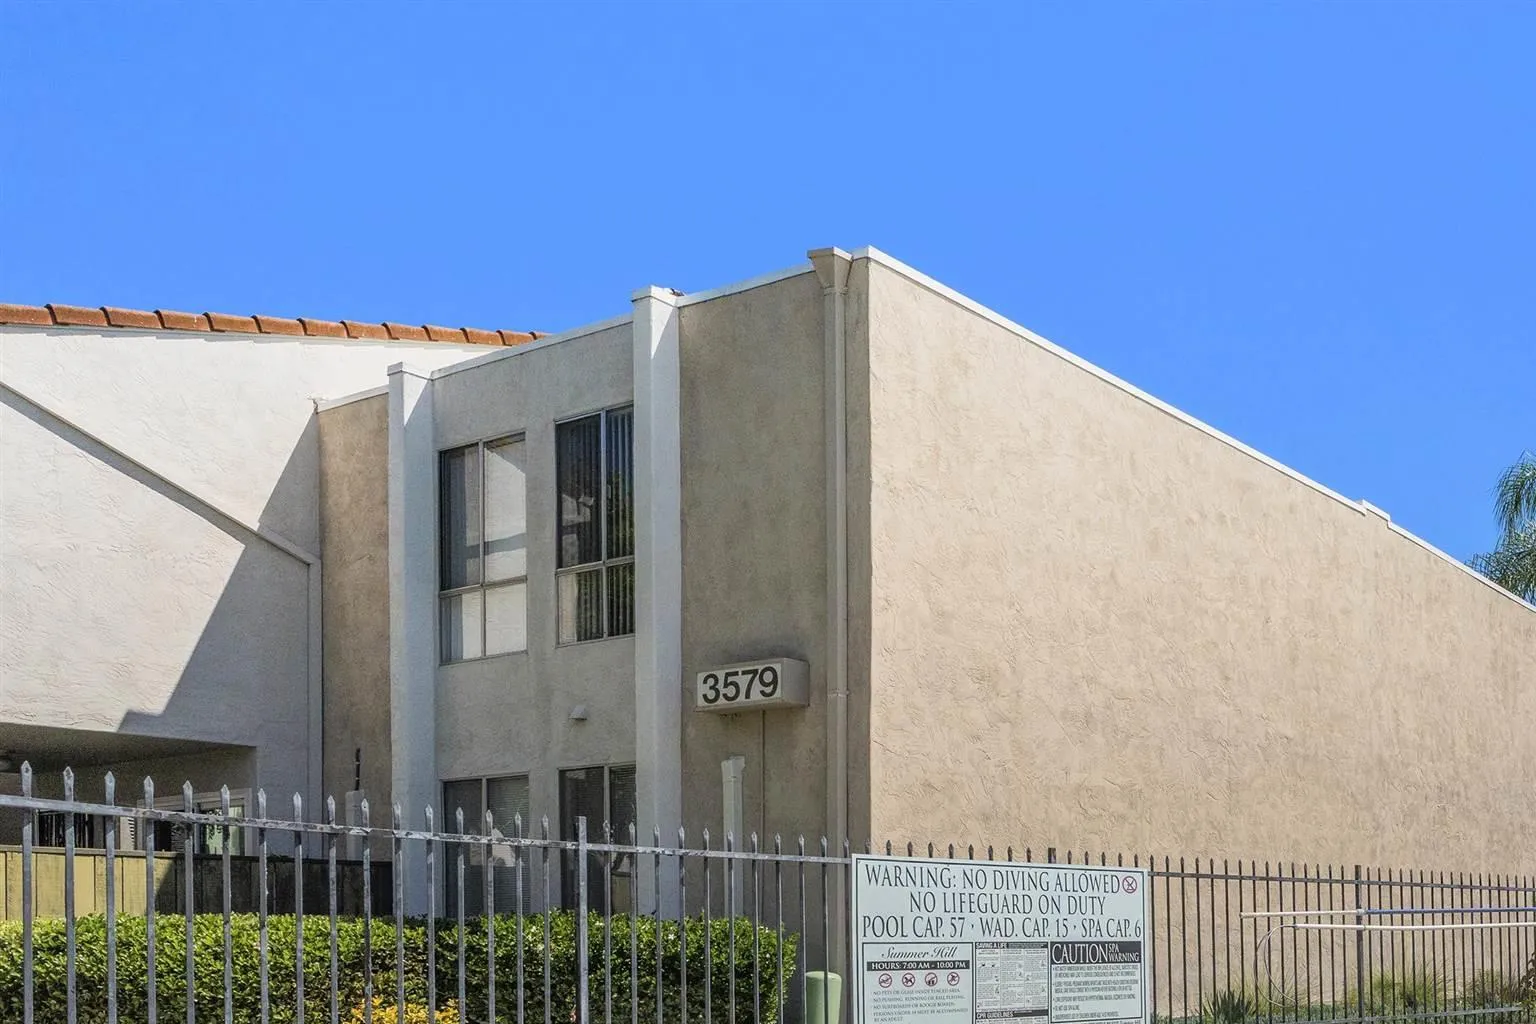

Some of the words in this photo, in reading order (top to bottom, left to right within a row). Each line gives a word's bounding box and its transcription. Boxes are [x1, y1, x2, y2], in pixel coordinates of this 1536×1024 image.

[702, 666, 778, 704] 3579
[866, 864, 956, 889] WARNING:
[962, 869, 988, 890] NO
[993, 870, 1050, 892] DIVING
[1055, 872, 1120, 894] ALLOWED
[910, 891, 936, 913] NO
[943, 892, 1033, 915] LIFEGUARD
[1038, 895, 1061, 915] ON
[1067, 896, 1106, 915] DUTY
[862, 916, 908, 938] POOL
[912, 916, 944, 938] CAP.
[950, 918, 965, 938] 57
[980, 918, 1018, 938] WAD.
[1022, 918, 1050, 938] CAP.
[1055, 918, 1068, 938] 15
[1081, 919, 1102, 938] SPA
[1106, 919, 1132, 938] CAP.
[1134, 920, 1141, 938] 6
[881, 947, 929, 958] Summer
[932, 946, 958, 958] Hill
[1052, 944, 1108, 964] CAUTION
[1108, 944, 1119, 953] SPA
[1108, 950, 1139, 962] WARNING
